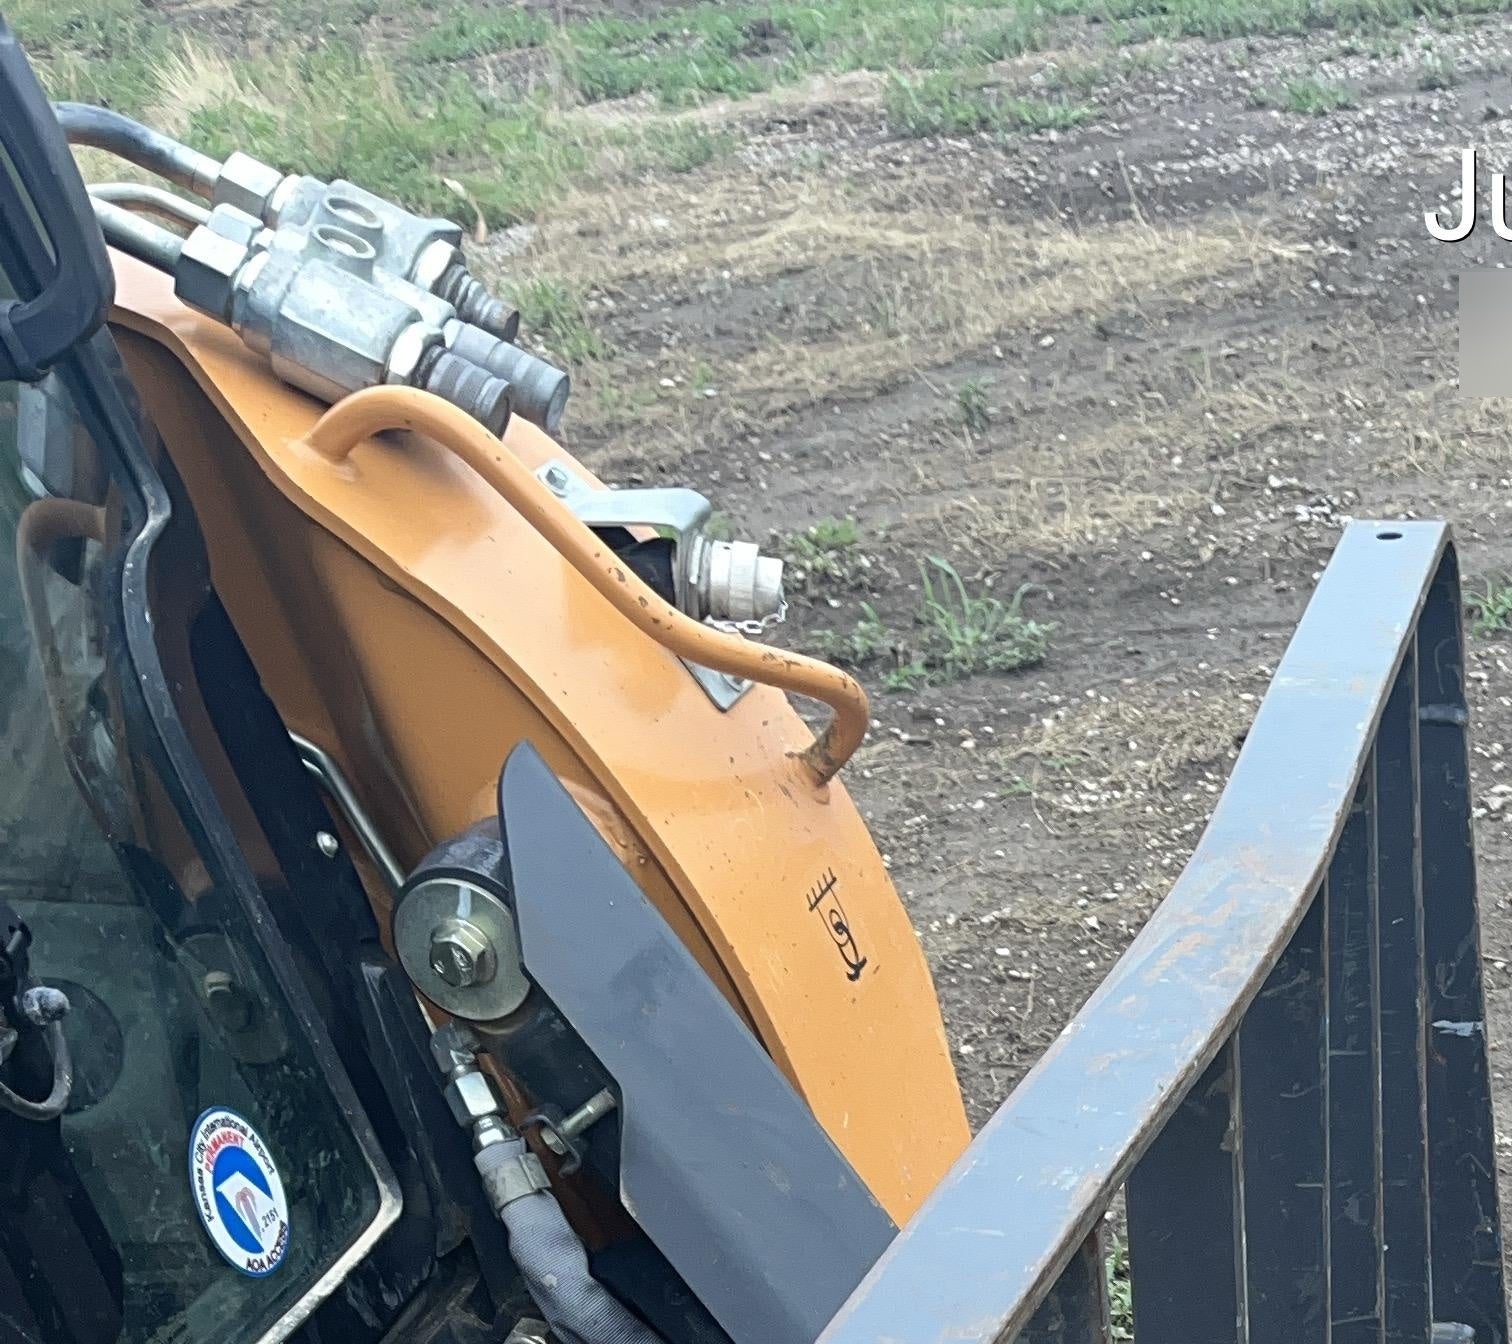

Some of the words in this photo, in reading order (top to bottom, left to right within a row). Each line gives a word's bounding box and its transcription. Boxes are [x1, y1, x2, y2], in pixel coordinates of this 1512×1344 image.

[200, 1115, 248, 1140] International
[195, 1139, 207, 1164] City
[204, 1130, 245, 1175] PERMANENT
[249, 1133, 275, 1175] Airport
[196, 1168, 215, 1222] Kansas
[246, 1257, 268, 1271] AOA
